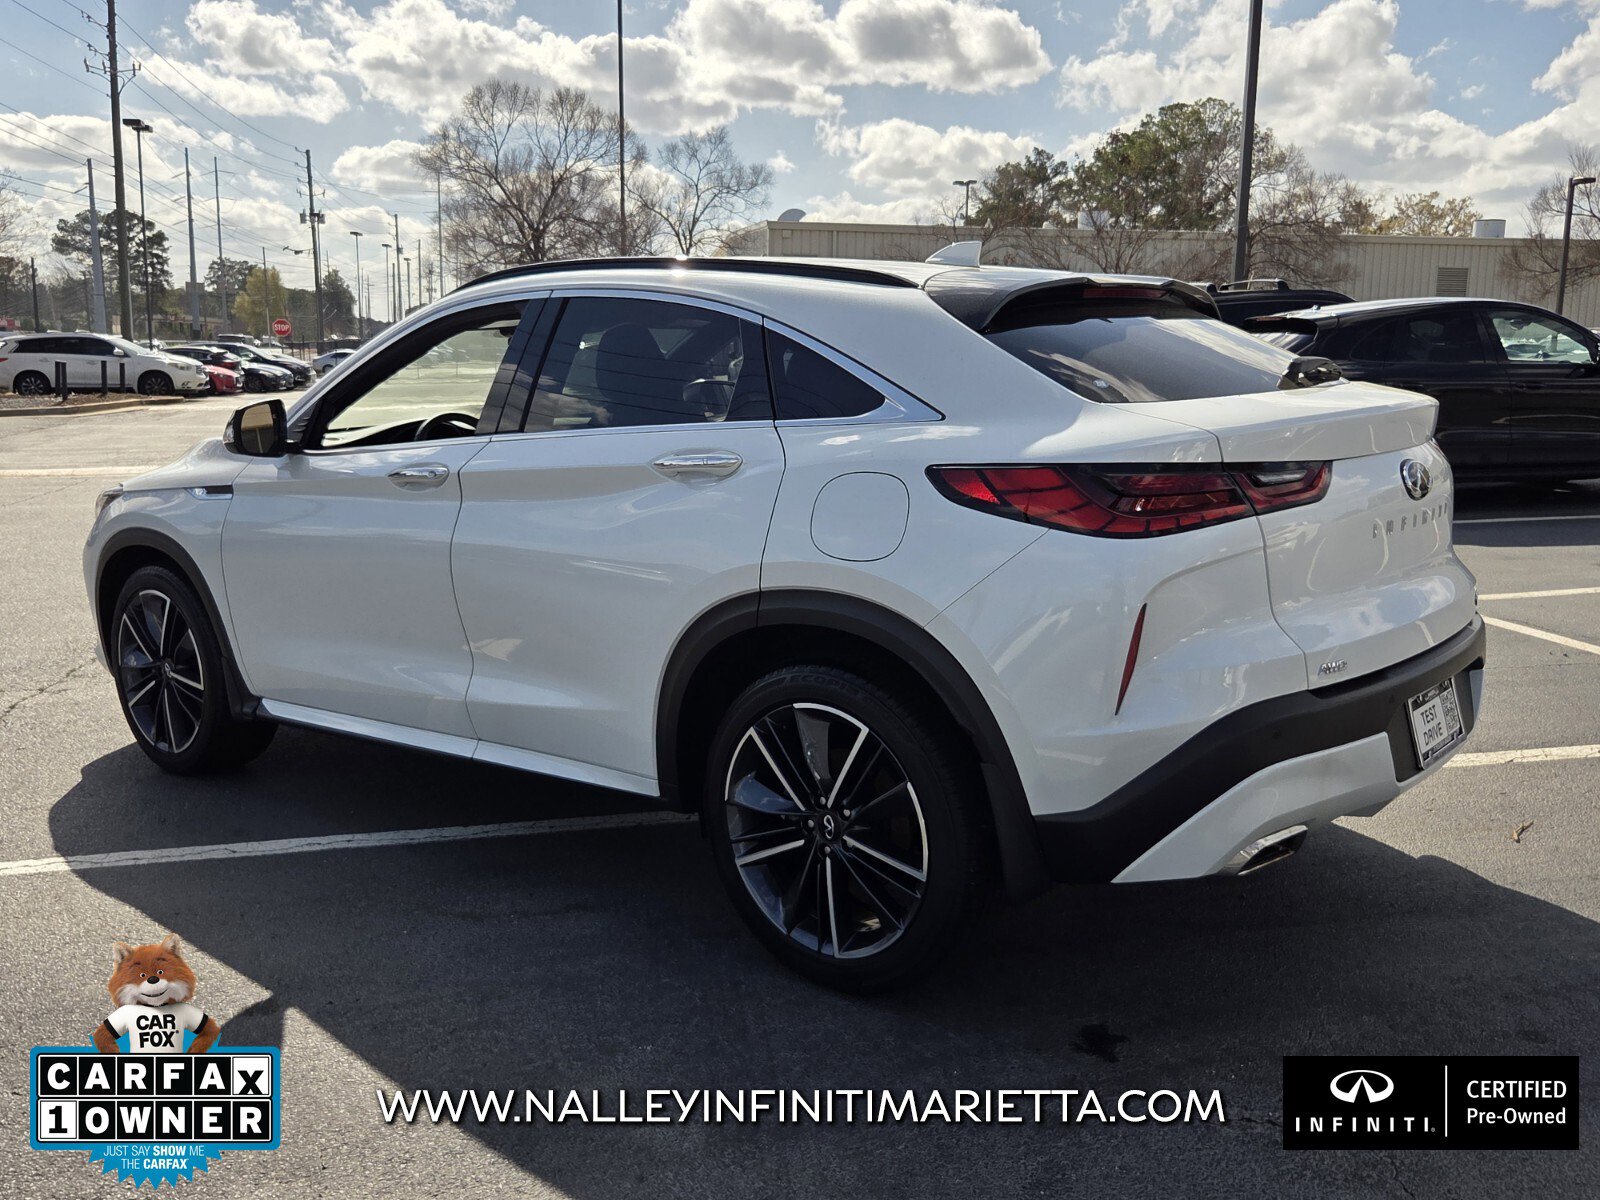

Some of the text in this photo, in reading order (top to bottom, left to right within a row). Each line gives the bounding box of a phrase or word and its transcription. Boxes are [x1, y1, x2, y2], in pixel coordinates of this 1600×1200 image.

[274, 323, 290, 331] STOP
[1420, 704, 1438, 726] TEST
[1423, 721, 1444, 746] DRIVE
